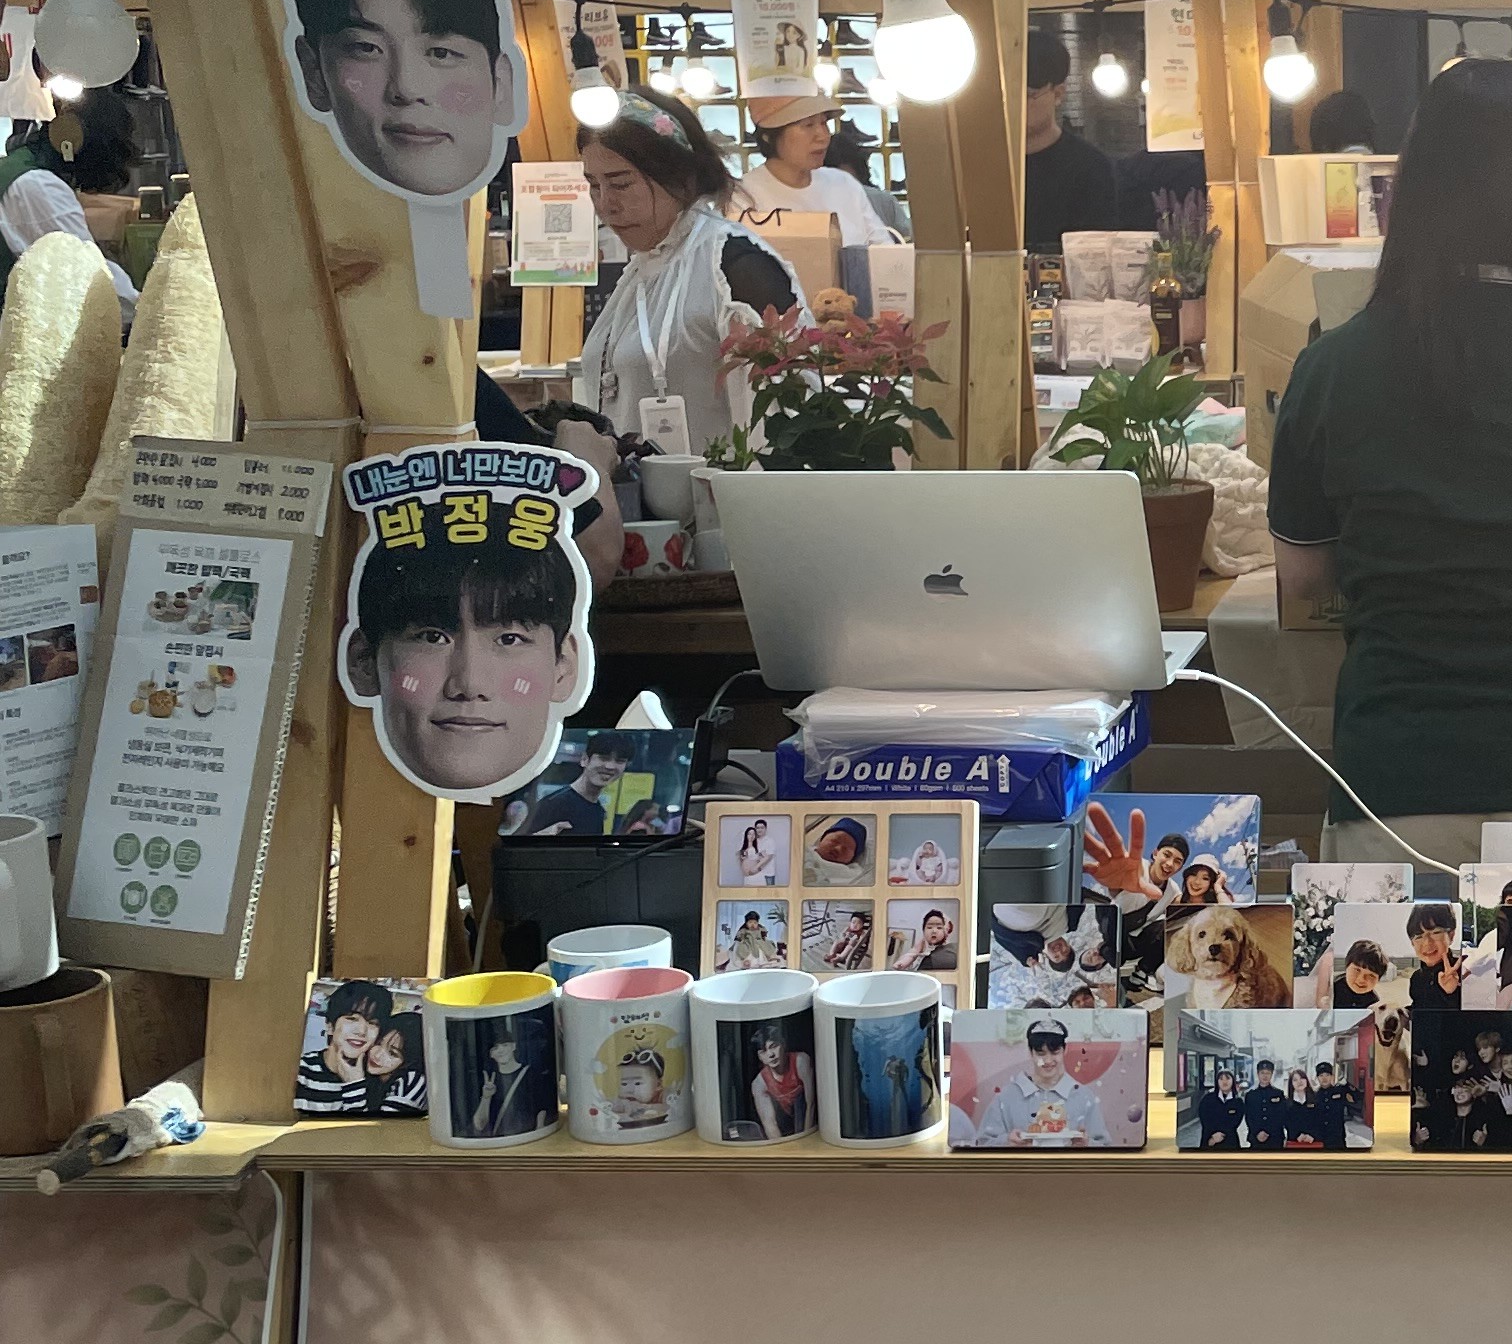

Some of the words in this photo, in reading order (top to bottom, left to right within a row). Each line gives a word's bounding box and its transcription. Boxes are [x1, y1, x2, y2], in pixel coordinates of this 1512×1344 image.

[355, 456, 437, 499] 내눈엔
[447, 452, 556, 487] 너만보여
[825, 755, 952, 781] Double
[966, 756, 989, 781] A
